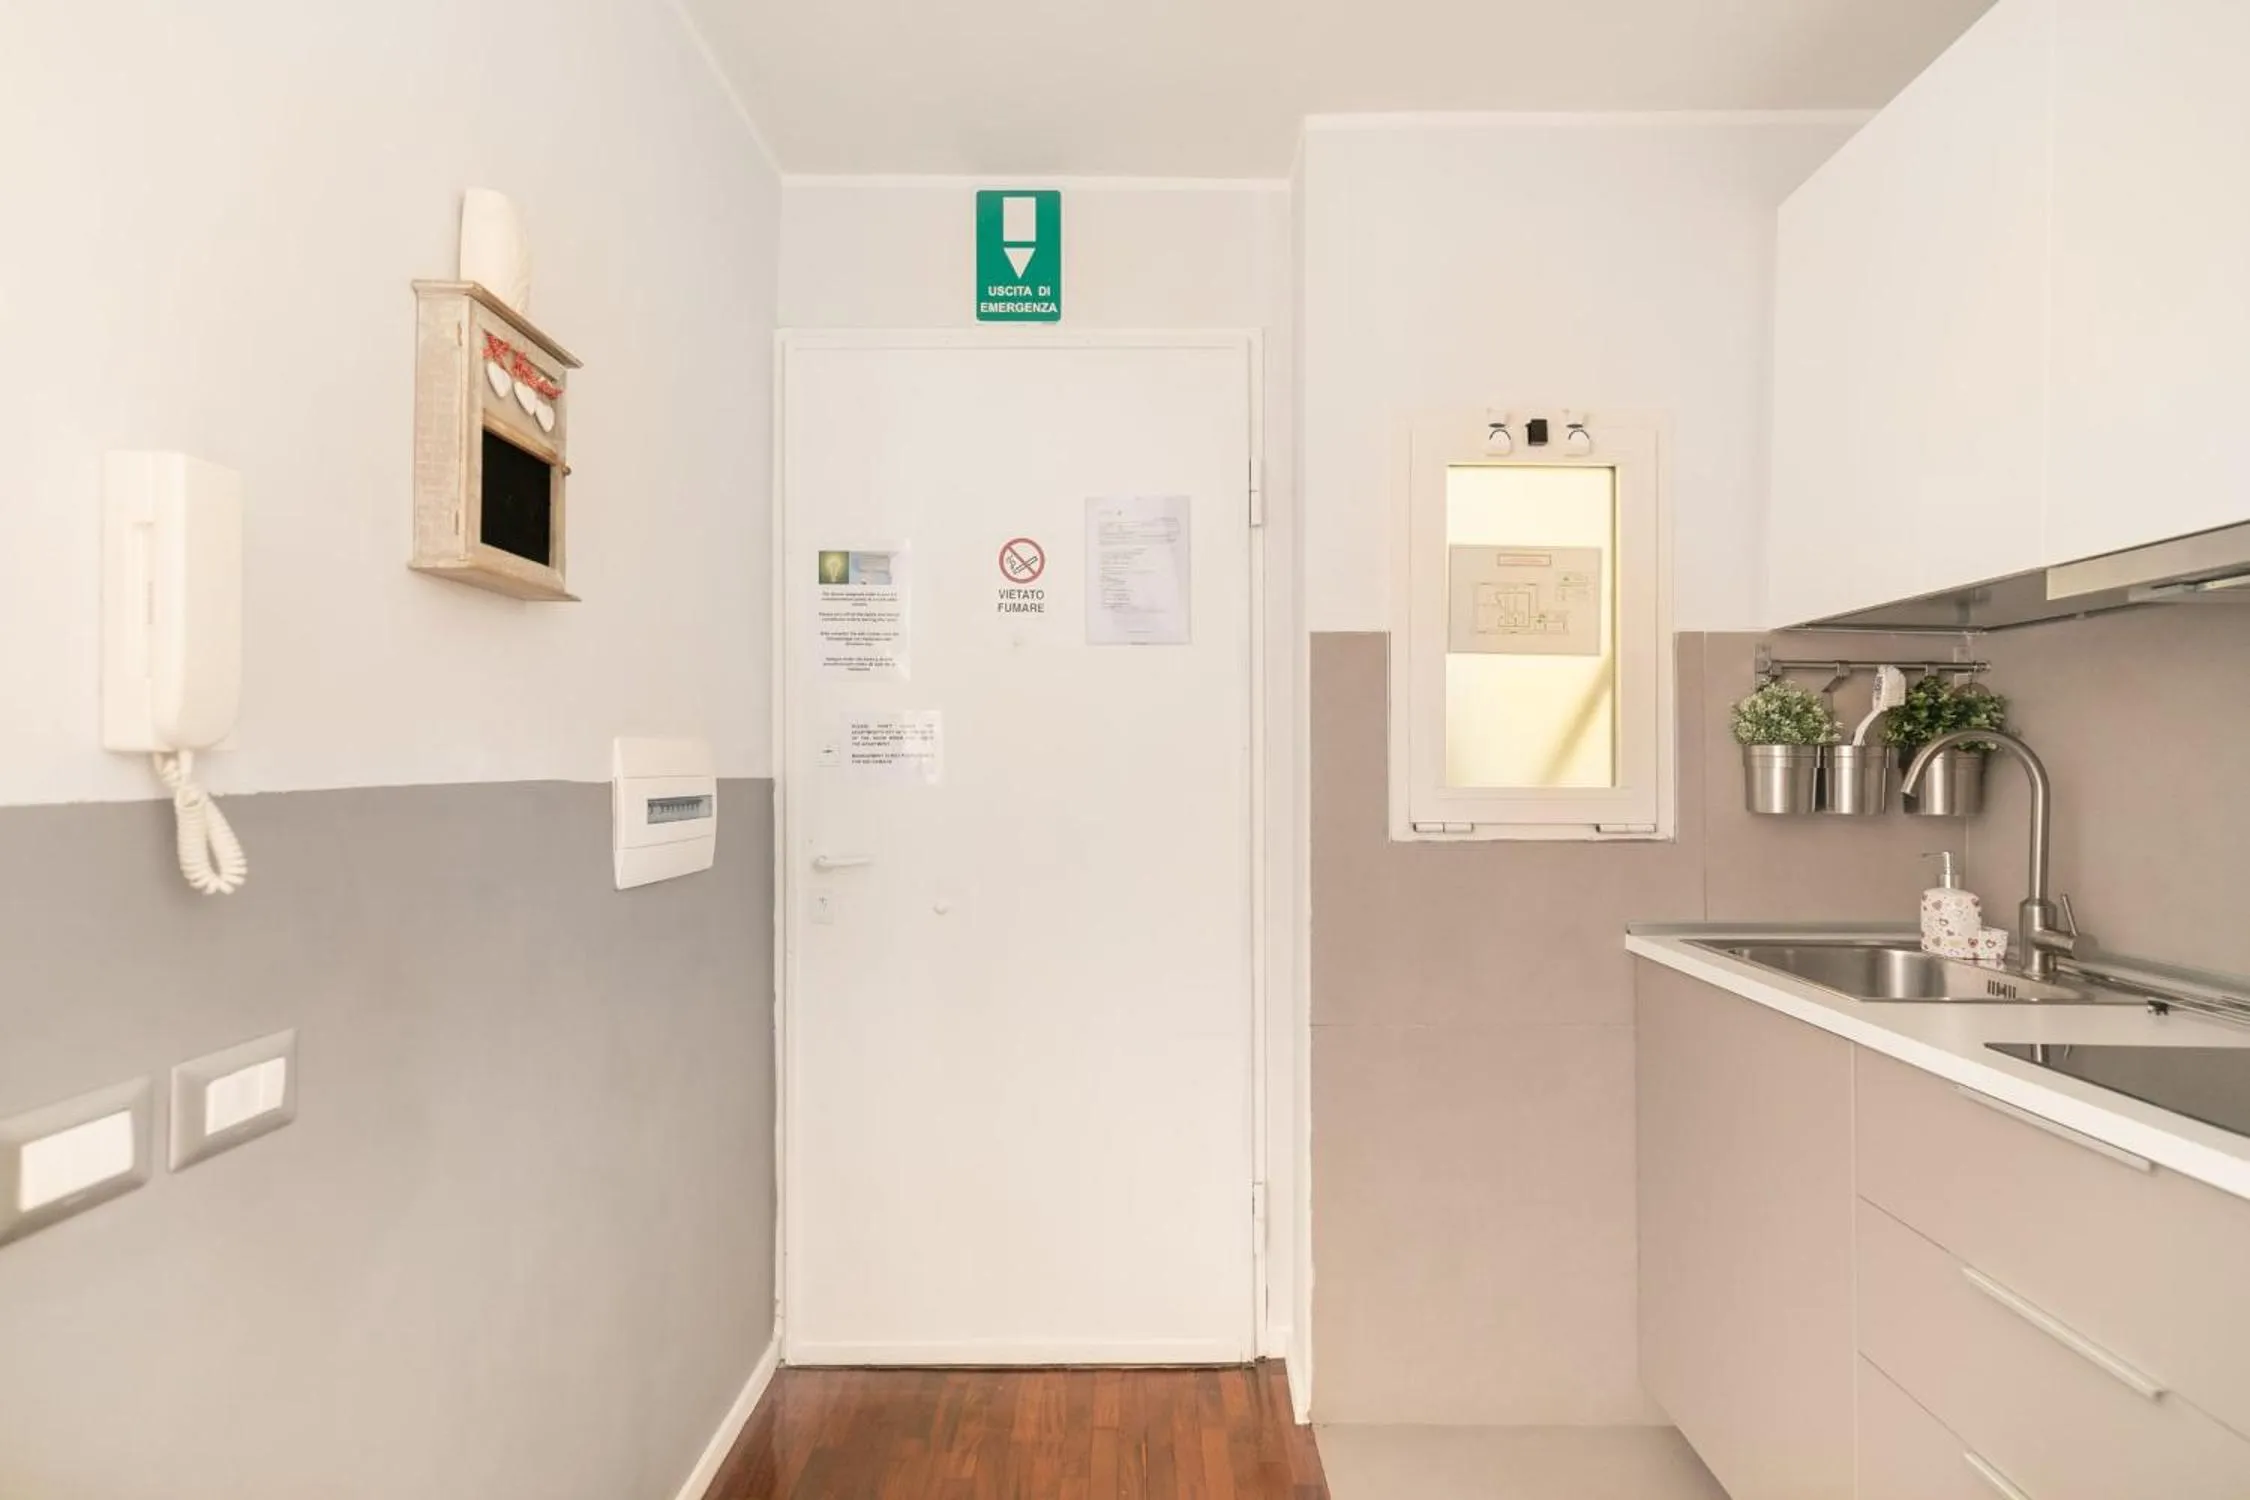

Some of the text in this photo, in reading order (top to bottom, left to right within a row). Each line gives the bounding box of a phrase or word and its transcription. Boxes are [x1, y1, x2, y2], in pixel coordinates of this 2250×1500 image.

[988, 285, 1051, 297] USCITA DI
[980, 302, 1058, 313] EMERGENZA
[998, 588, 1045, 600] VIETATO
[997, 602, 1045, 613] FUMARE
